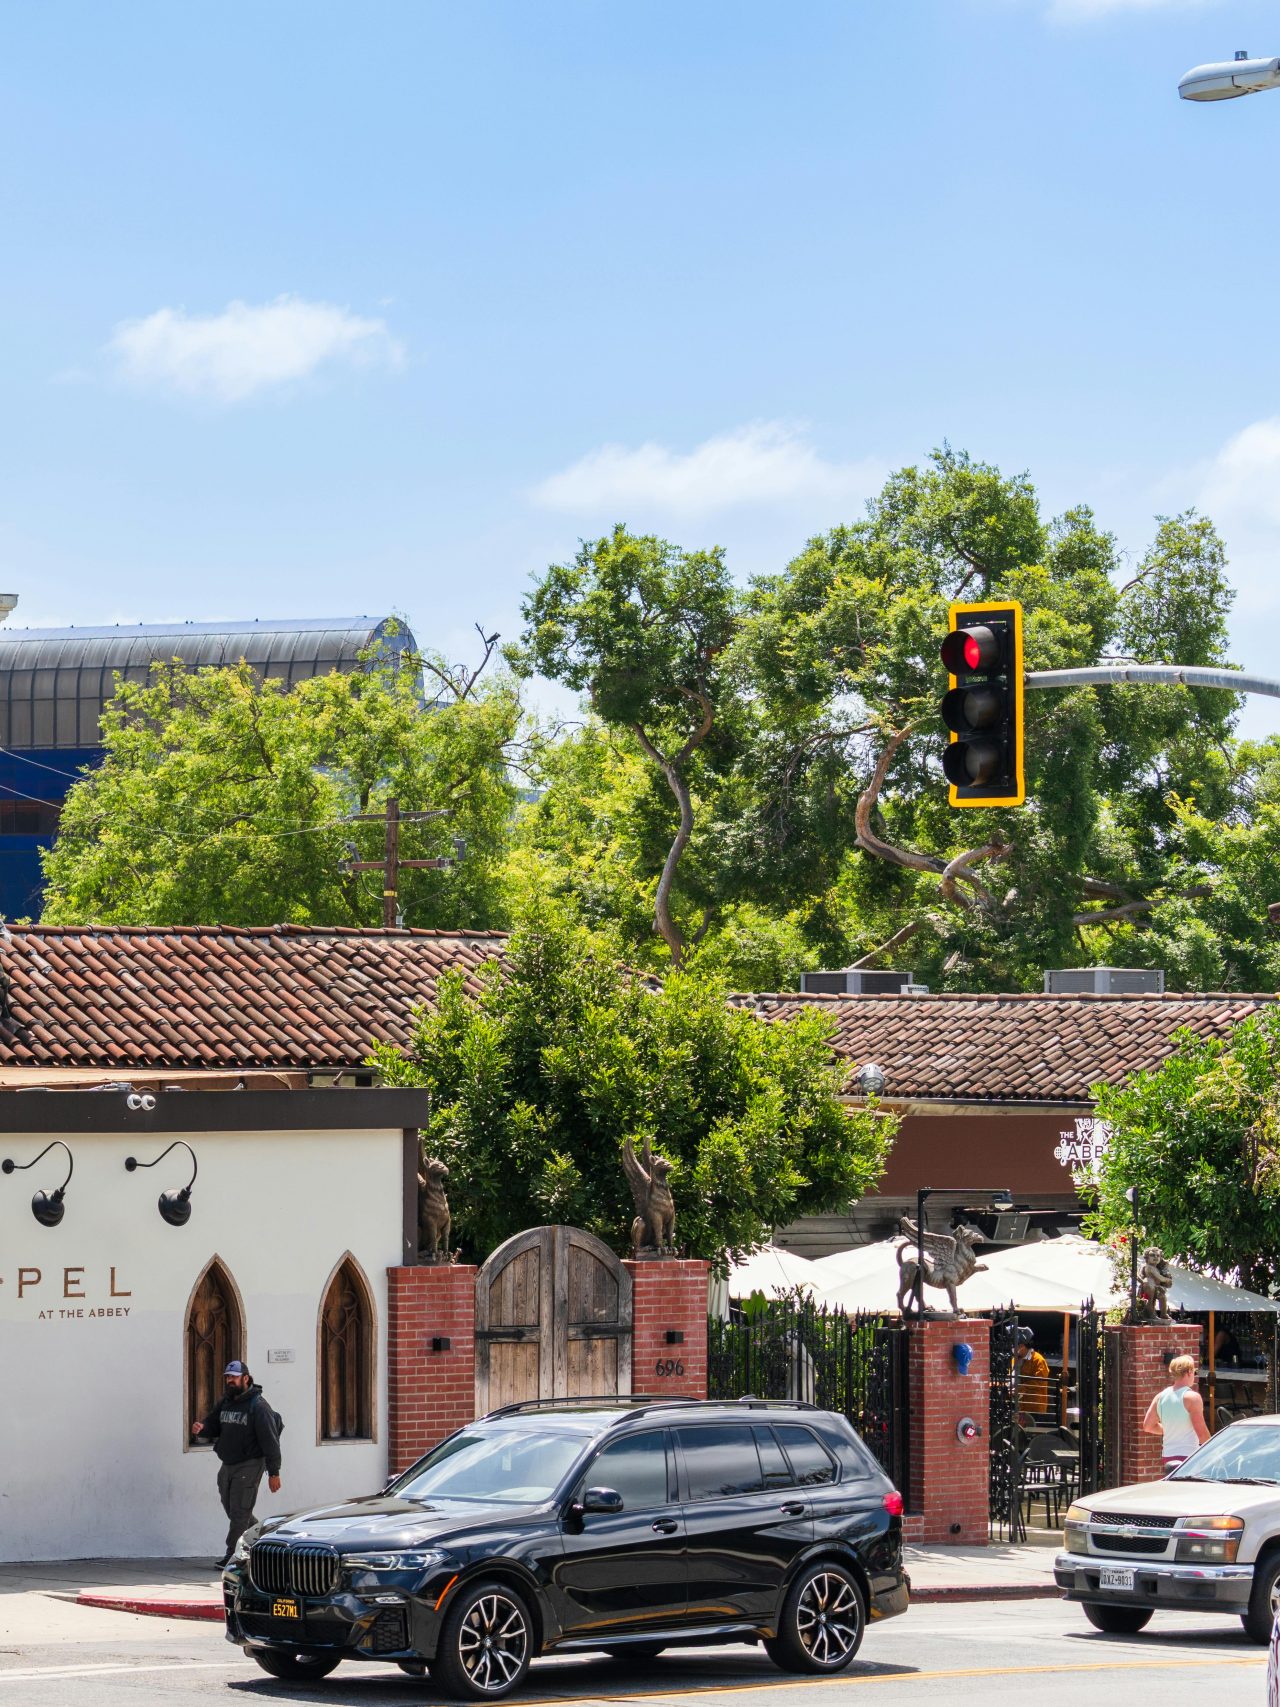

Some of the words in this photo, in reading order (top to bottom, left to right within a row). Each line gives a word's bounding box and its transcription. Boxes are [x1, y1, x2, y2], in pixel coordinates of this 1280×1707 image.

[1059, 1131, 1075, 1139] THE
[37, 1309, 54, 1320] AT
[59, 1308, 84, 1319] THE
[88, 1307, 131, 1318] ABBEY
[655, 1358, 684, 1377] 696
